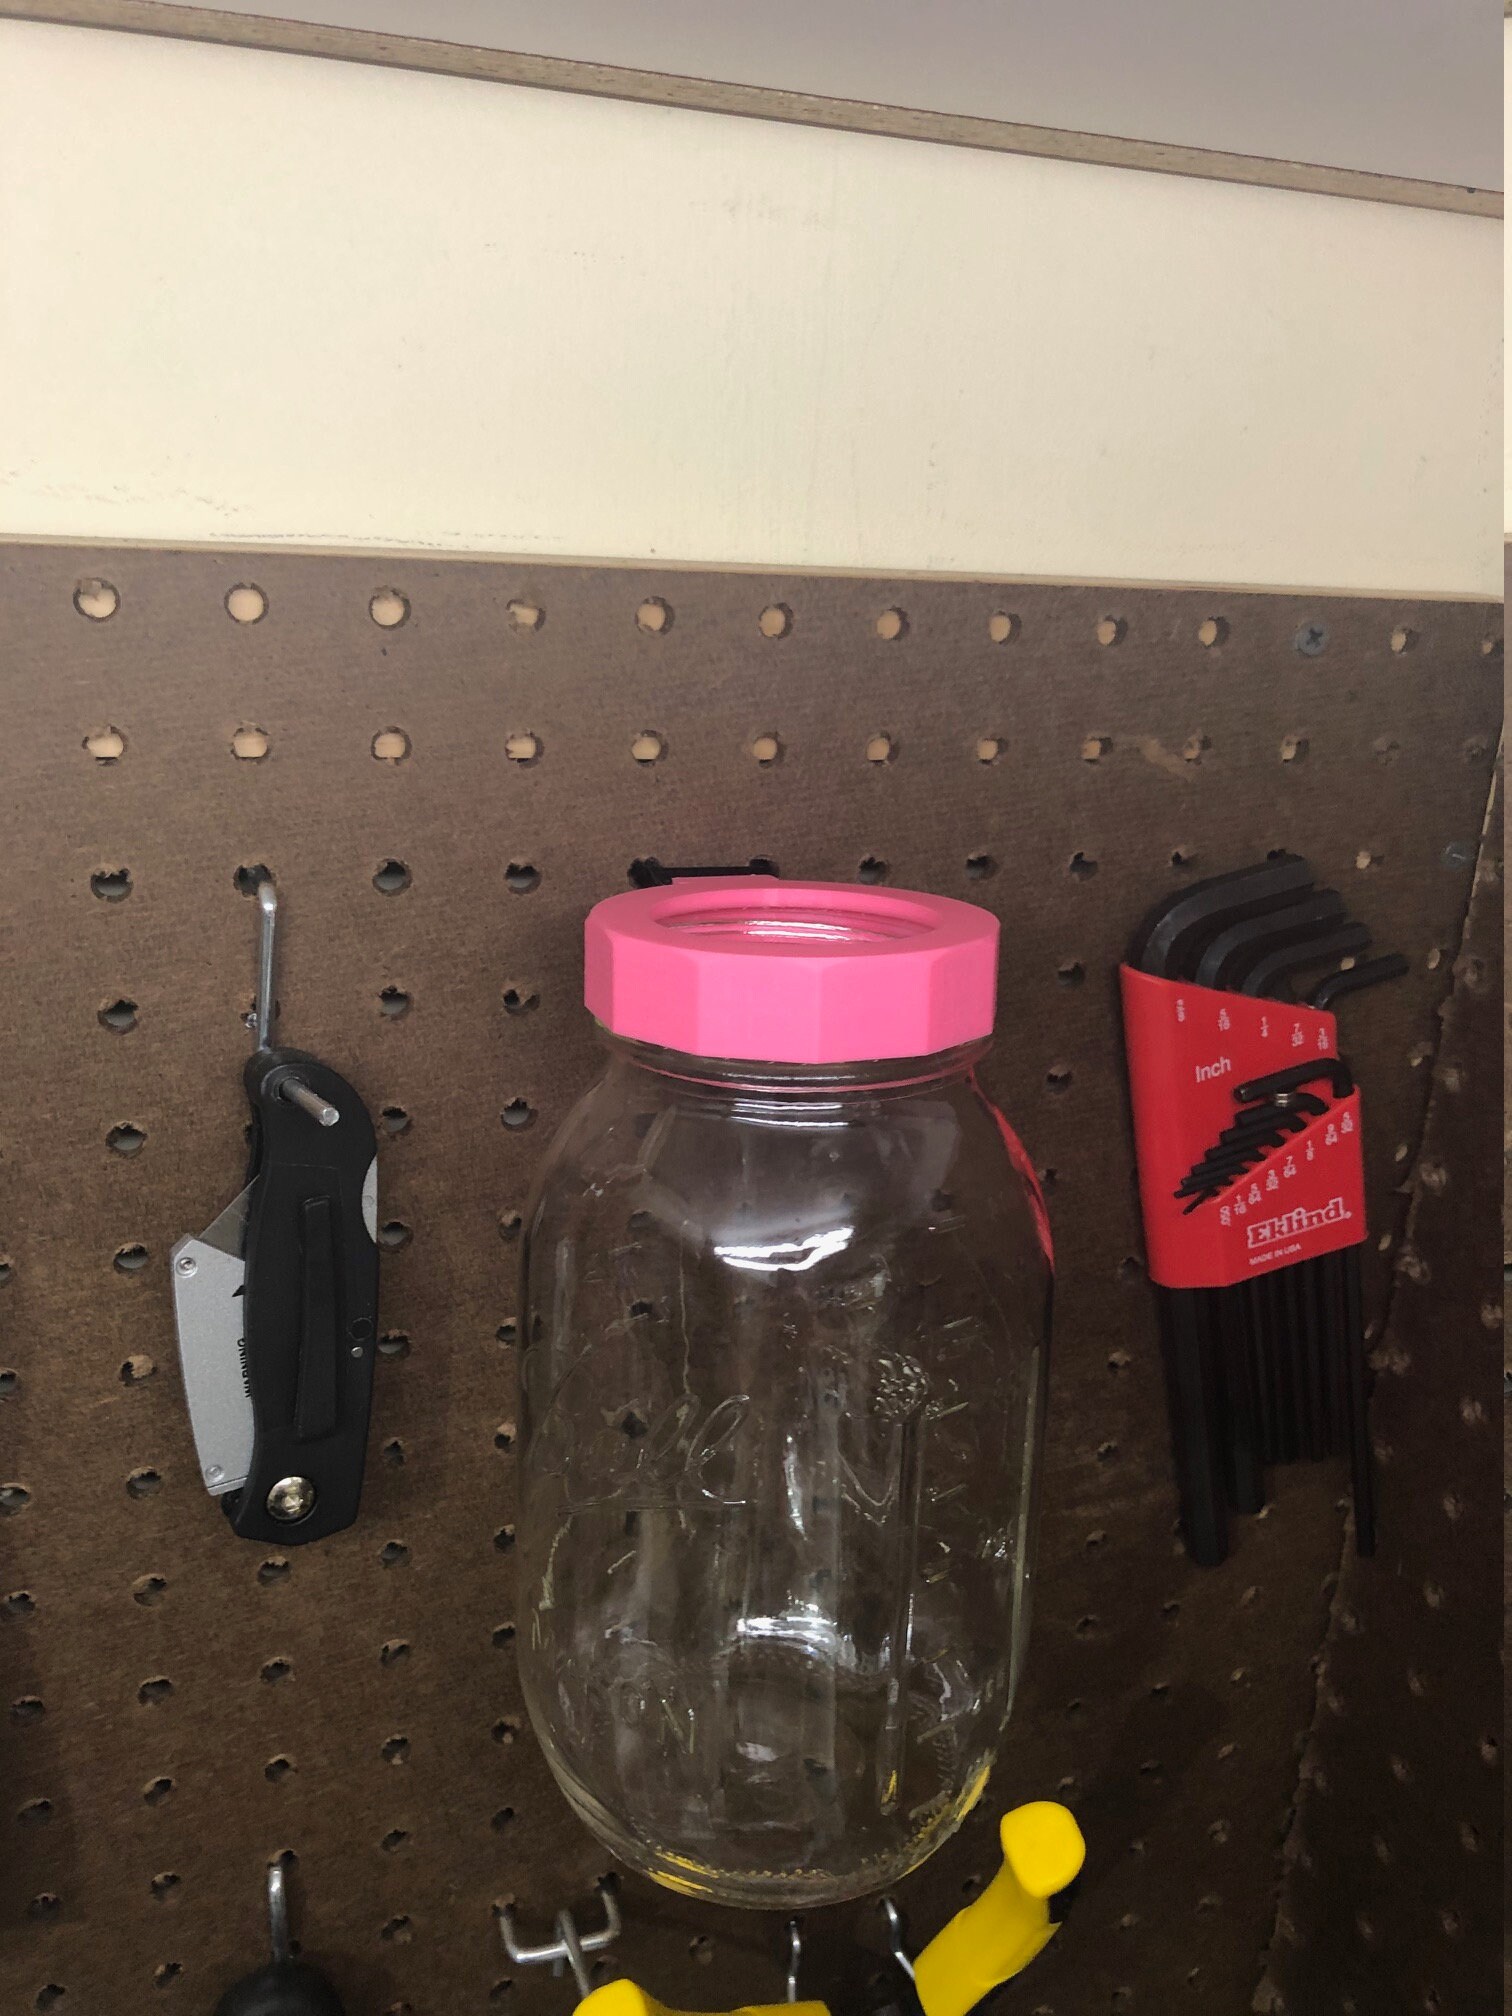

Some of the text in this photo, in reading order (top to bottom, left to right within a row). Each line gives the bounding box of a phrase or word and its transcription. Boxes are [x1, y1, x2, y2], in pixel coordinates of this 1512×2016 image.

[1195, 1056, 1231, 1083] Inch
[1247, 1197, 1344, 1248] Eklind
[1249, 1243, 1302, 1266] MADE IN USA
[237, 1337, 251, 1399] WARNING
